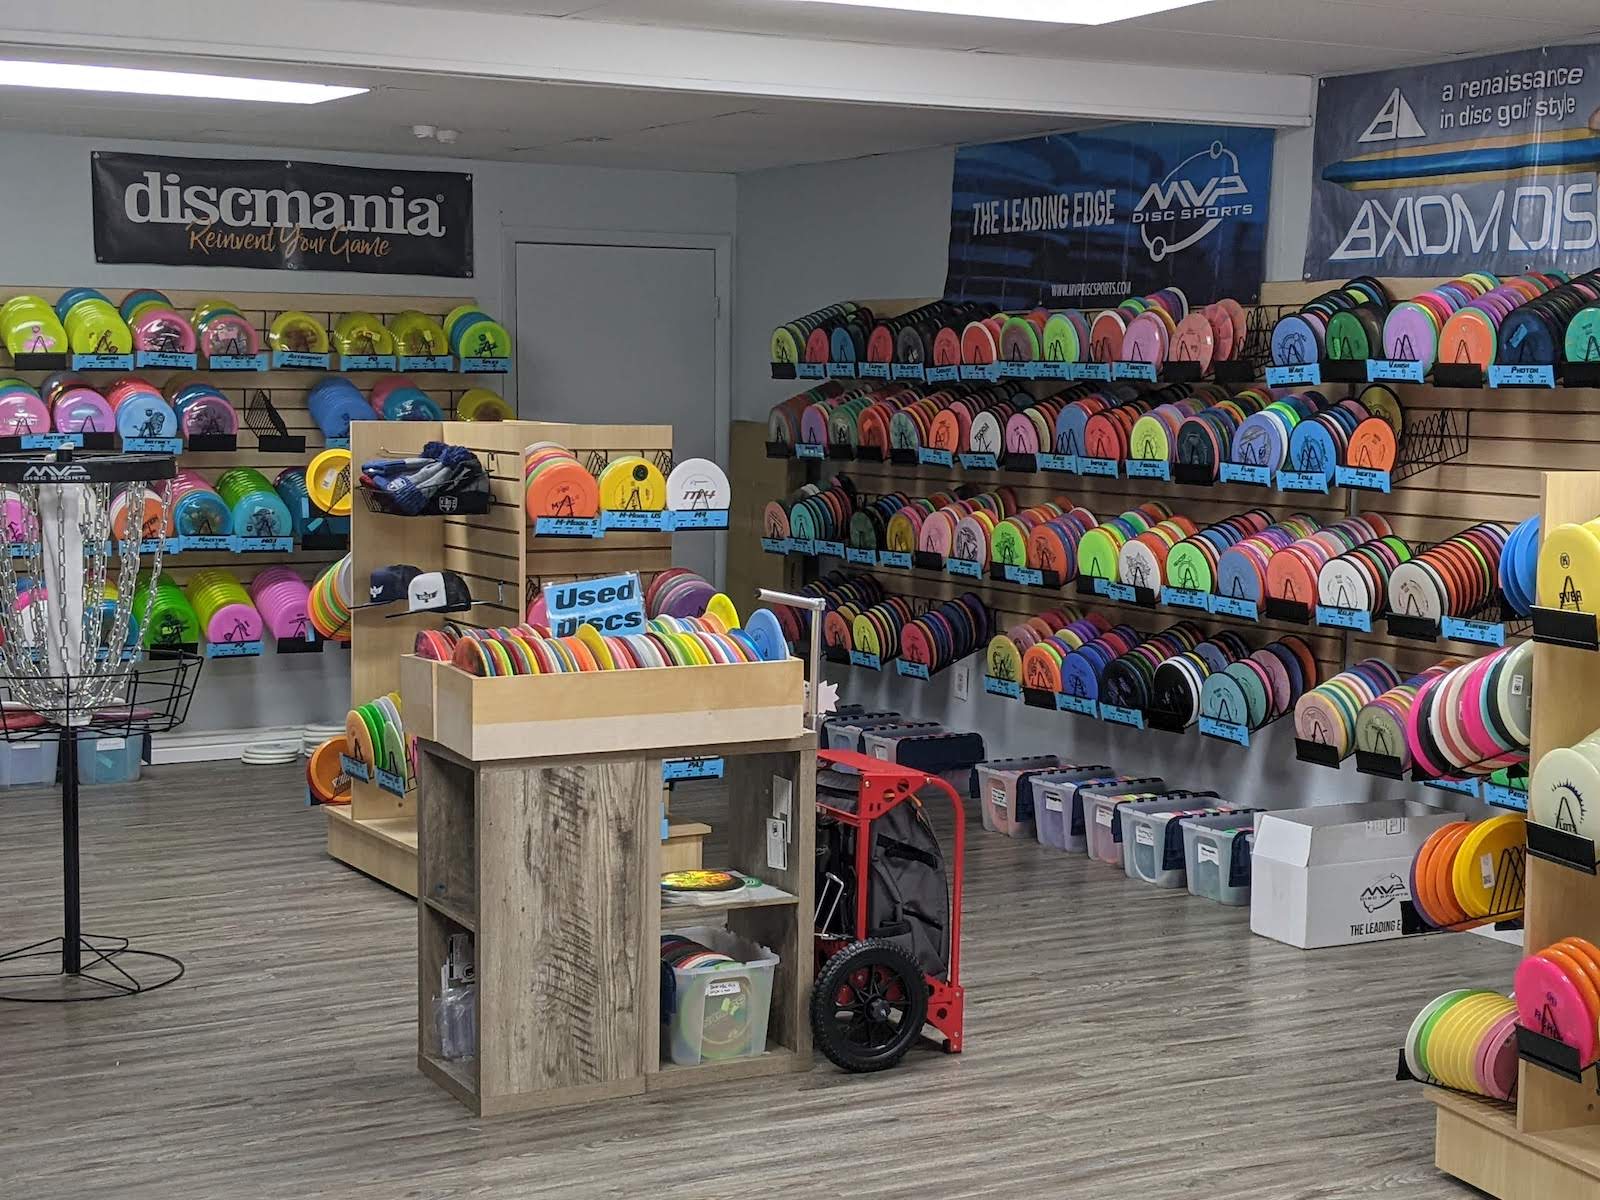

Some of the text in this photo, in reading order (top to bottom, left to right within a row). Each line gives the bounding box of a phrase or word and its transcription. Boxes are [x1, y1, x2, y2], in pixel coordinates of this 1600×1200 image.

[1442, 67, 1584, 102] a renaissance
[1440, 93, 1576, 129] in disc golf style
[1134, 175, 1248, 212] MVP
[972, 189, 1117, 236] THE LEADING EDGE
[1132, 204, 1252, 223] DISC SPORTS
[1328, 182, 1600, 260] AXIOM DIS
[187, 218, 393, 262] Reinvent Your Game
[24, 466, 87, 476] MVP
[556, 580, 635, 610] Used
[557, 611, 642, 639] Discs
[1350, 924, 1364, 936] THE
[1366, 920, 1396, 934] LEADING
